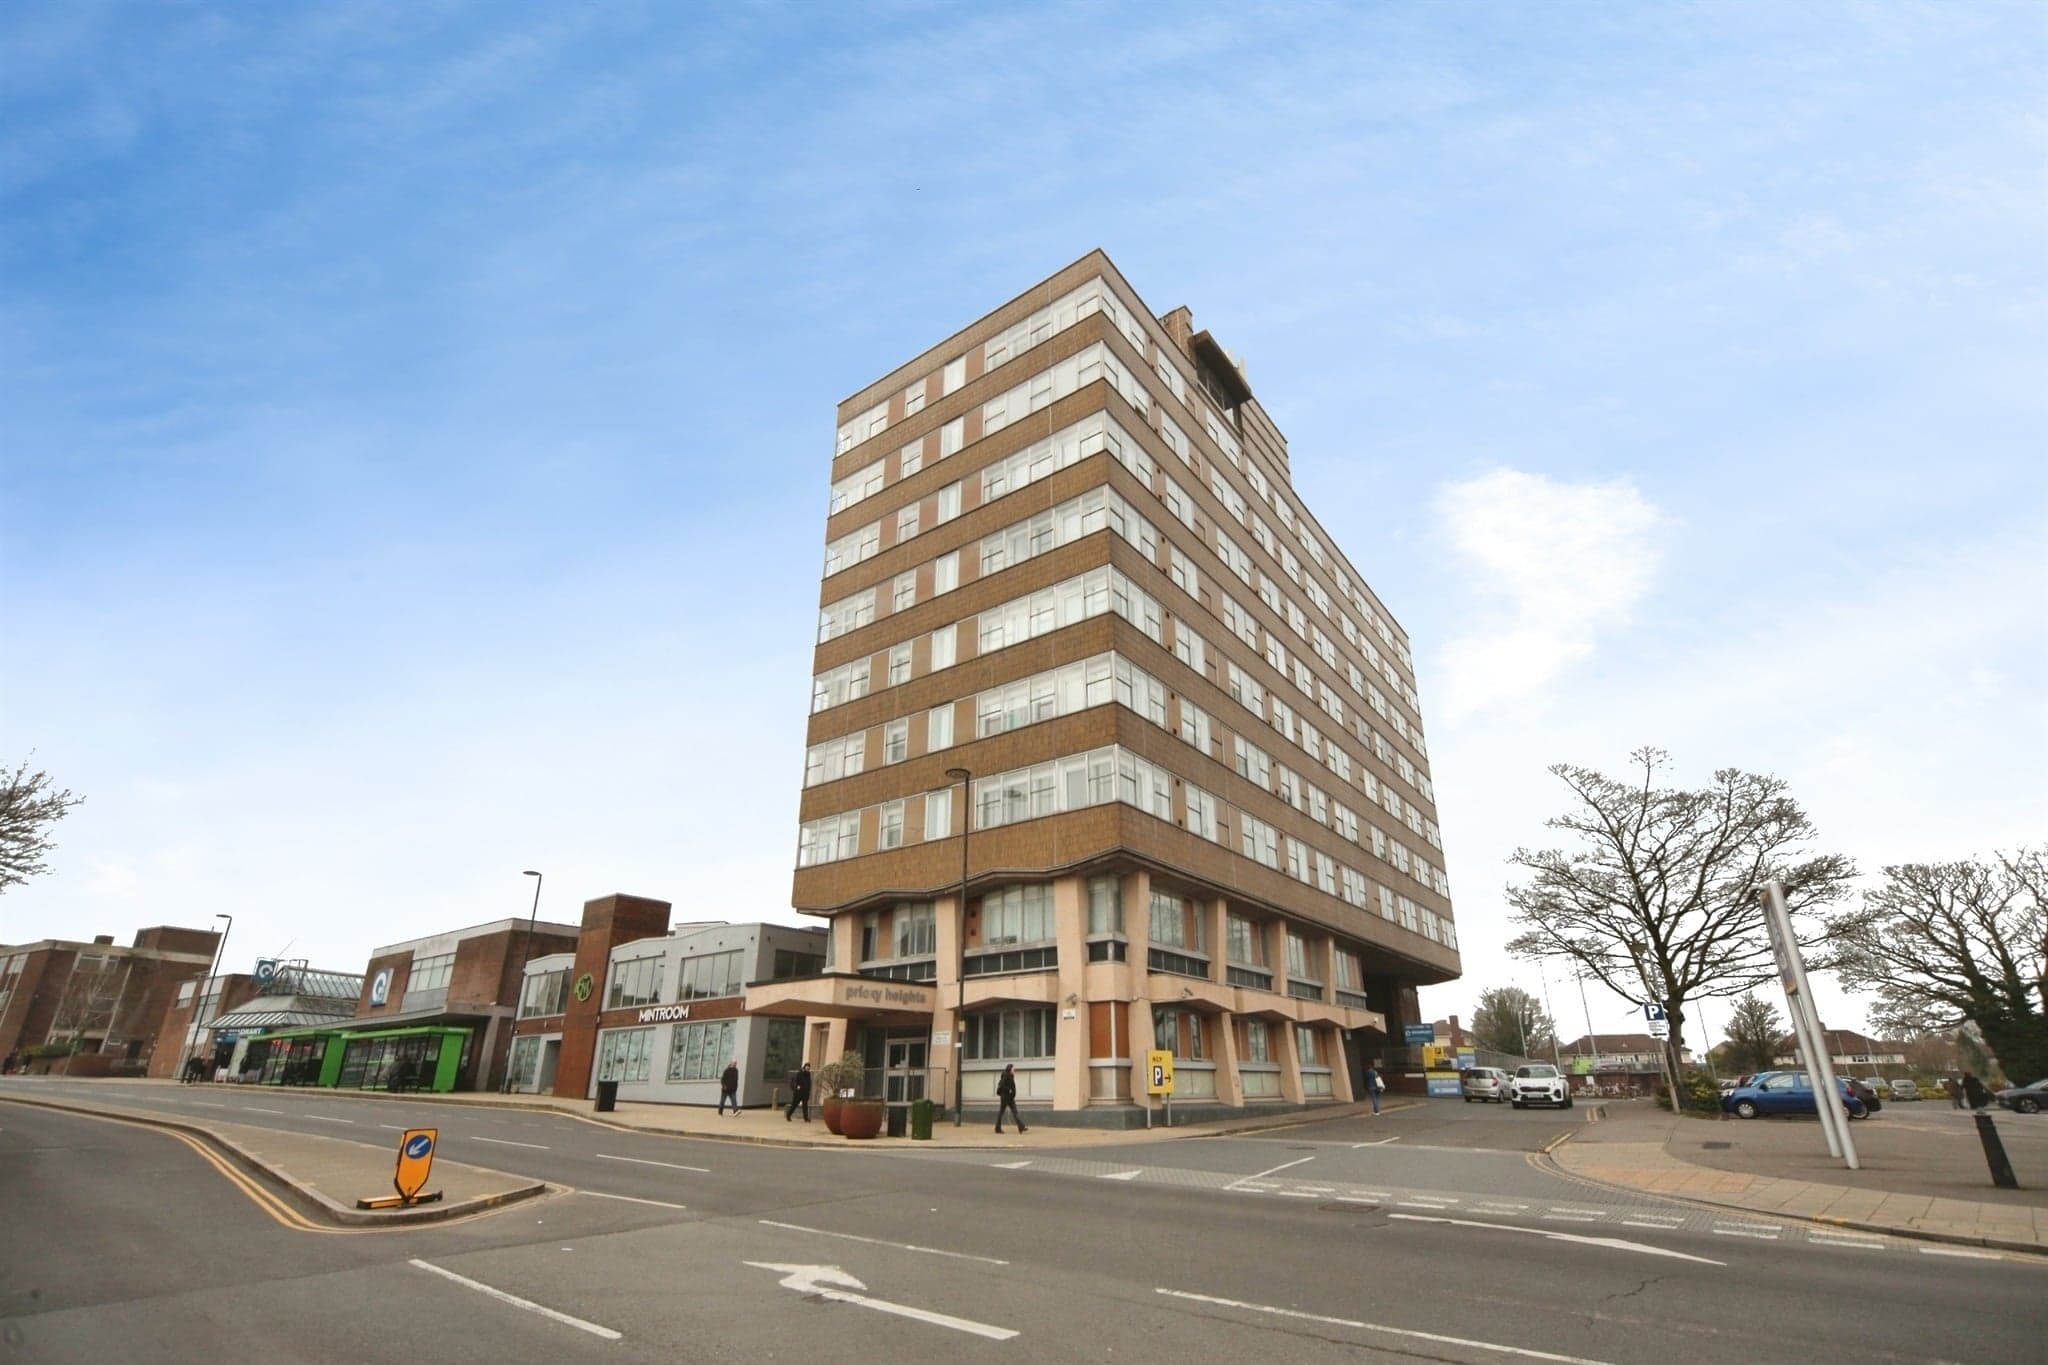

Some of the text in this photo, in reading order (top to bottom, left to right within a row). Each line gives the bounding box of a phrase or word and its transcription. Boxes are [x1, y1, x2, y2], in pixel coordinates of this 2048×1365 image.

[885, 988, 926, 1005] heights
[638, 1004, 690, 1022] MINTROOM
[1647, 1005, 1659, 1020] P
[1154, 1067, 1162, 1085] P
